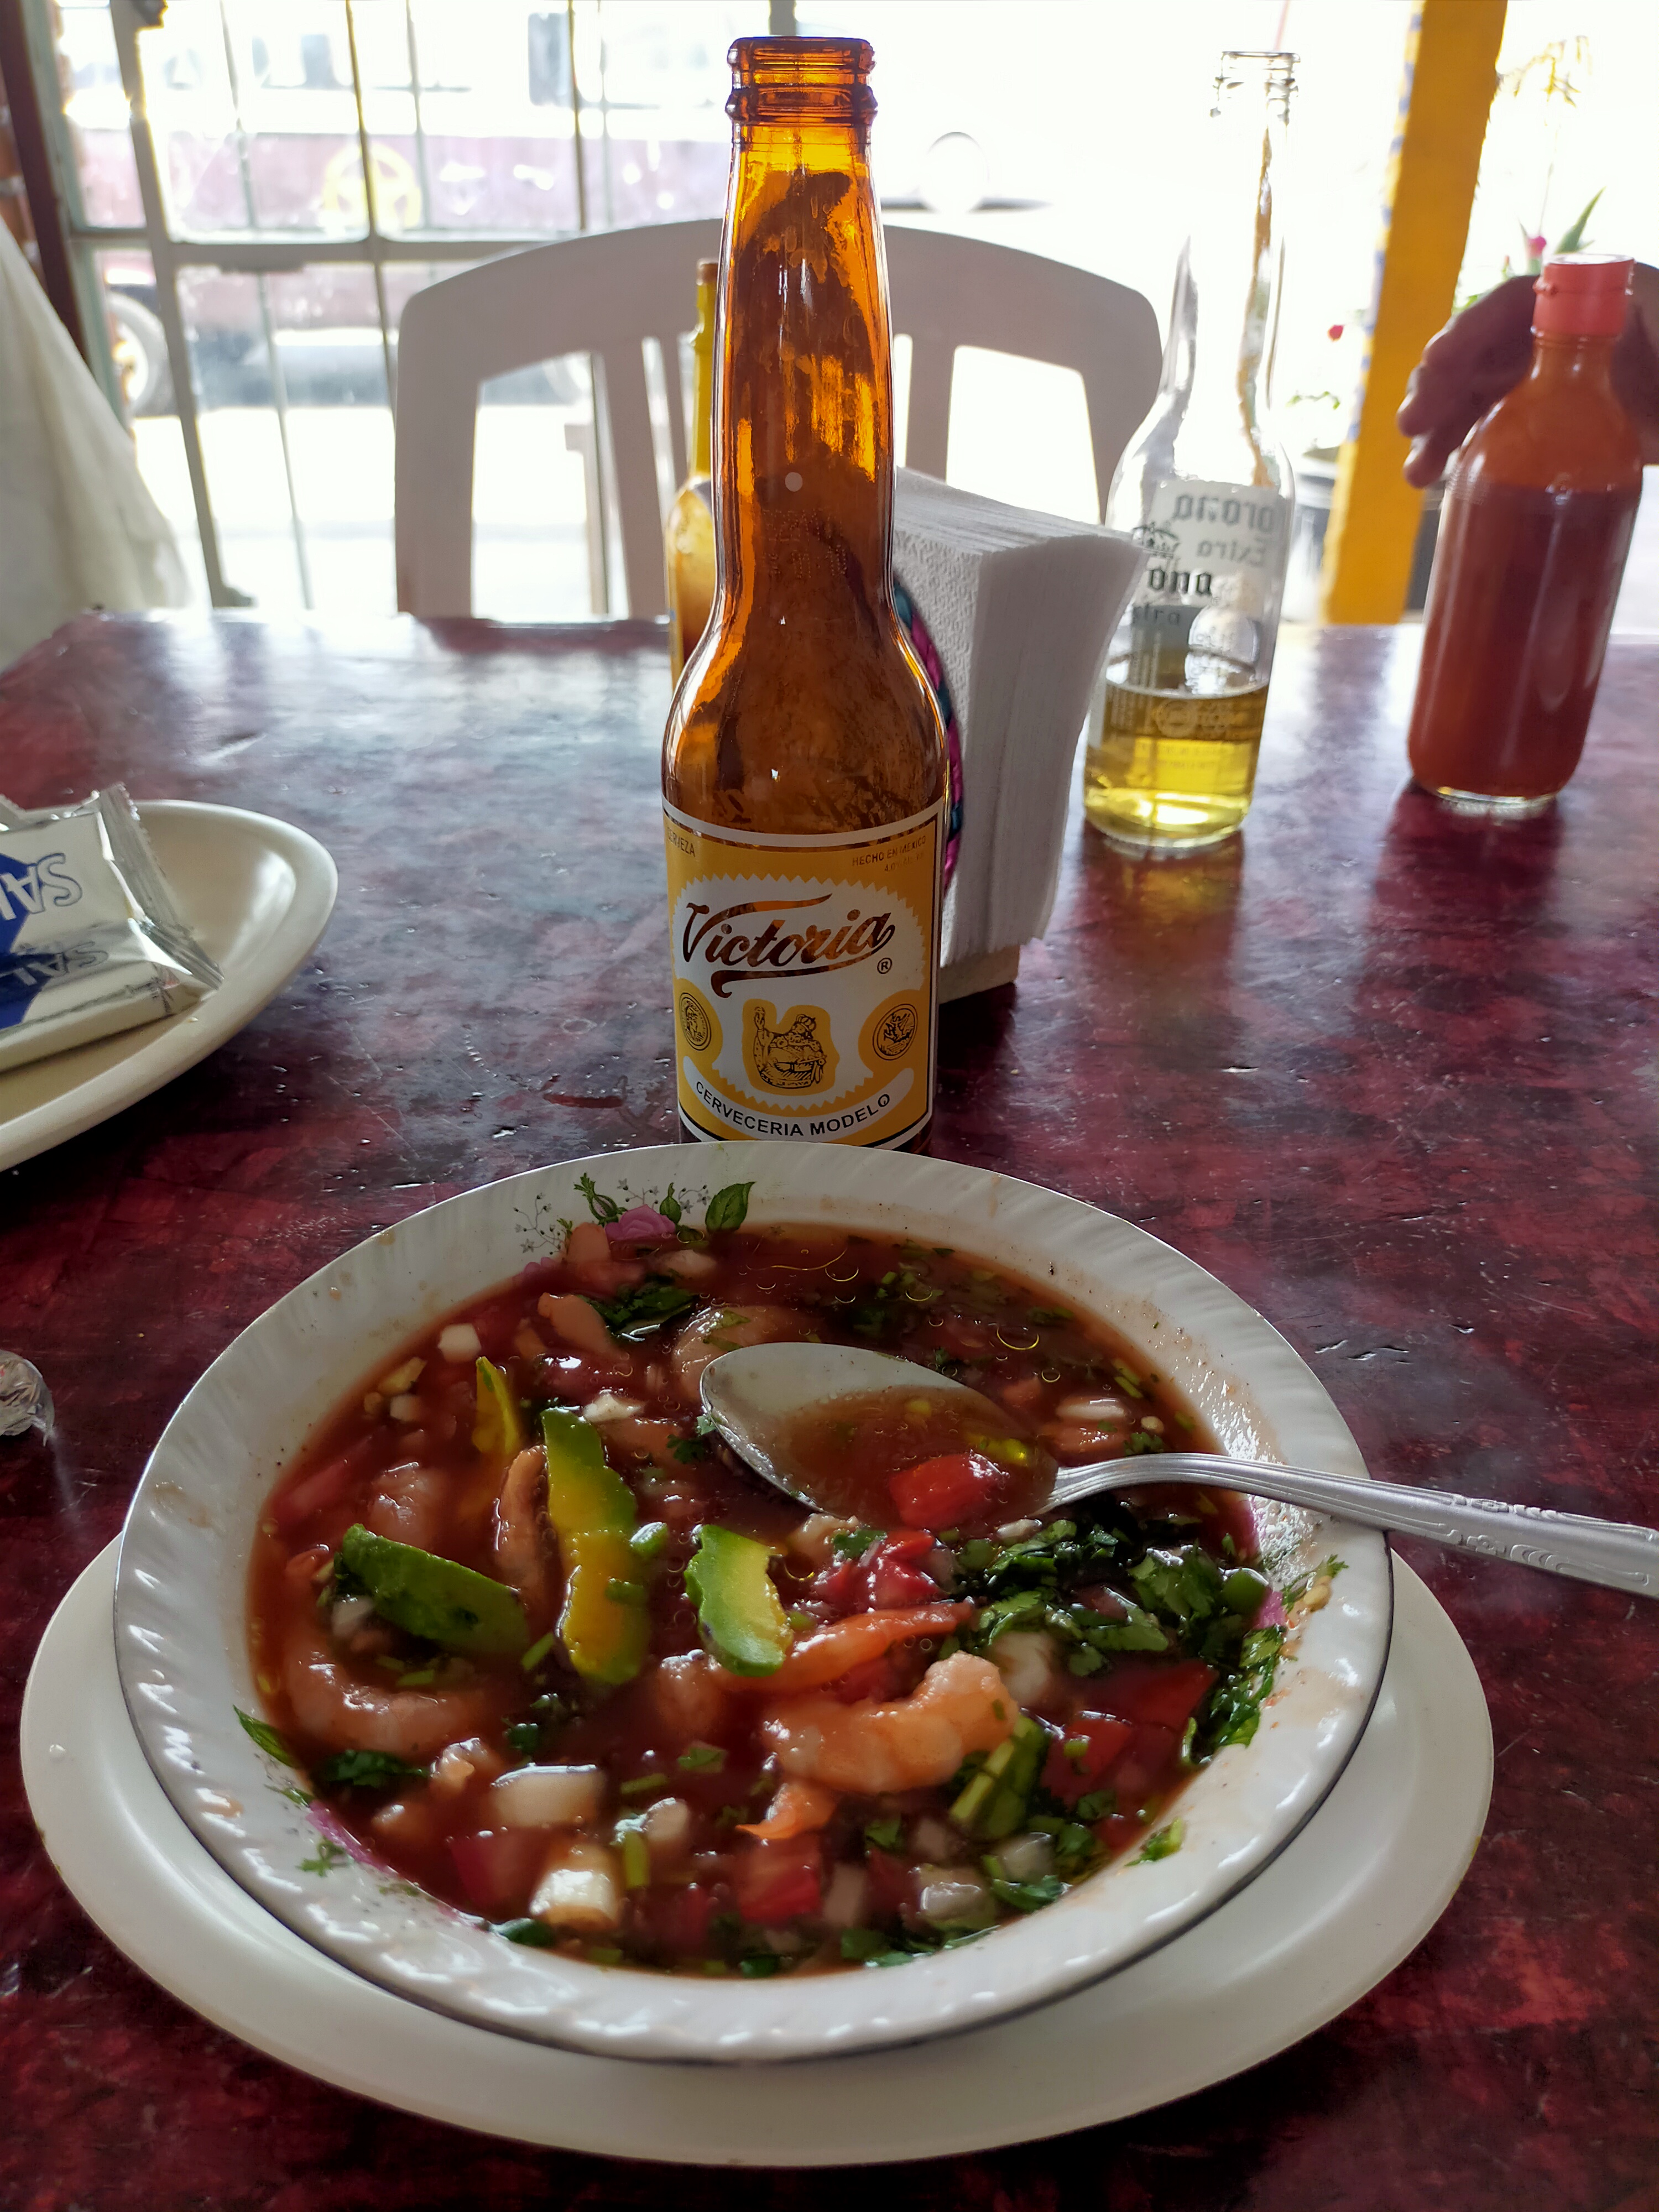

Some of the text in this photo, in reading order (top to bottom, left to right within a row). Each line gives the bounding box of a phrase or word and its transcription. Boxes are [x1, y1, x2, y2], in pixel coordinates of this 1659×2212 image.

[852, 852, 885, 867] HECHO
[887, 848, 898, 859] EN
[682, 893, 895, 998] Victoria
[696, 1081, 891, 1136] CERVECERIA MODELO
